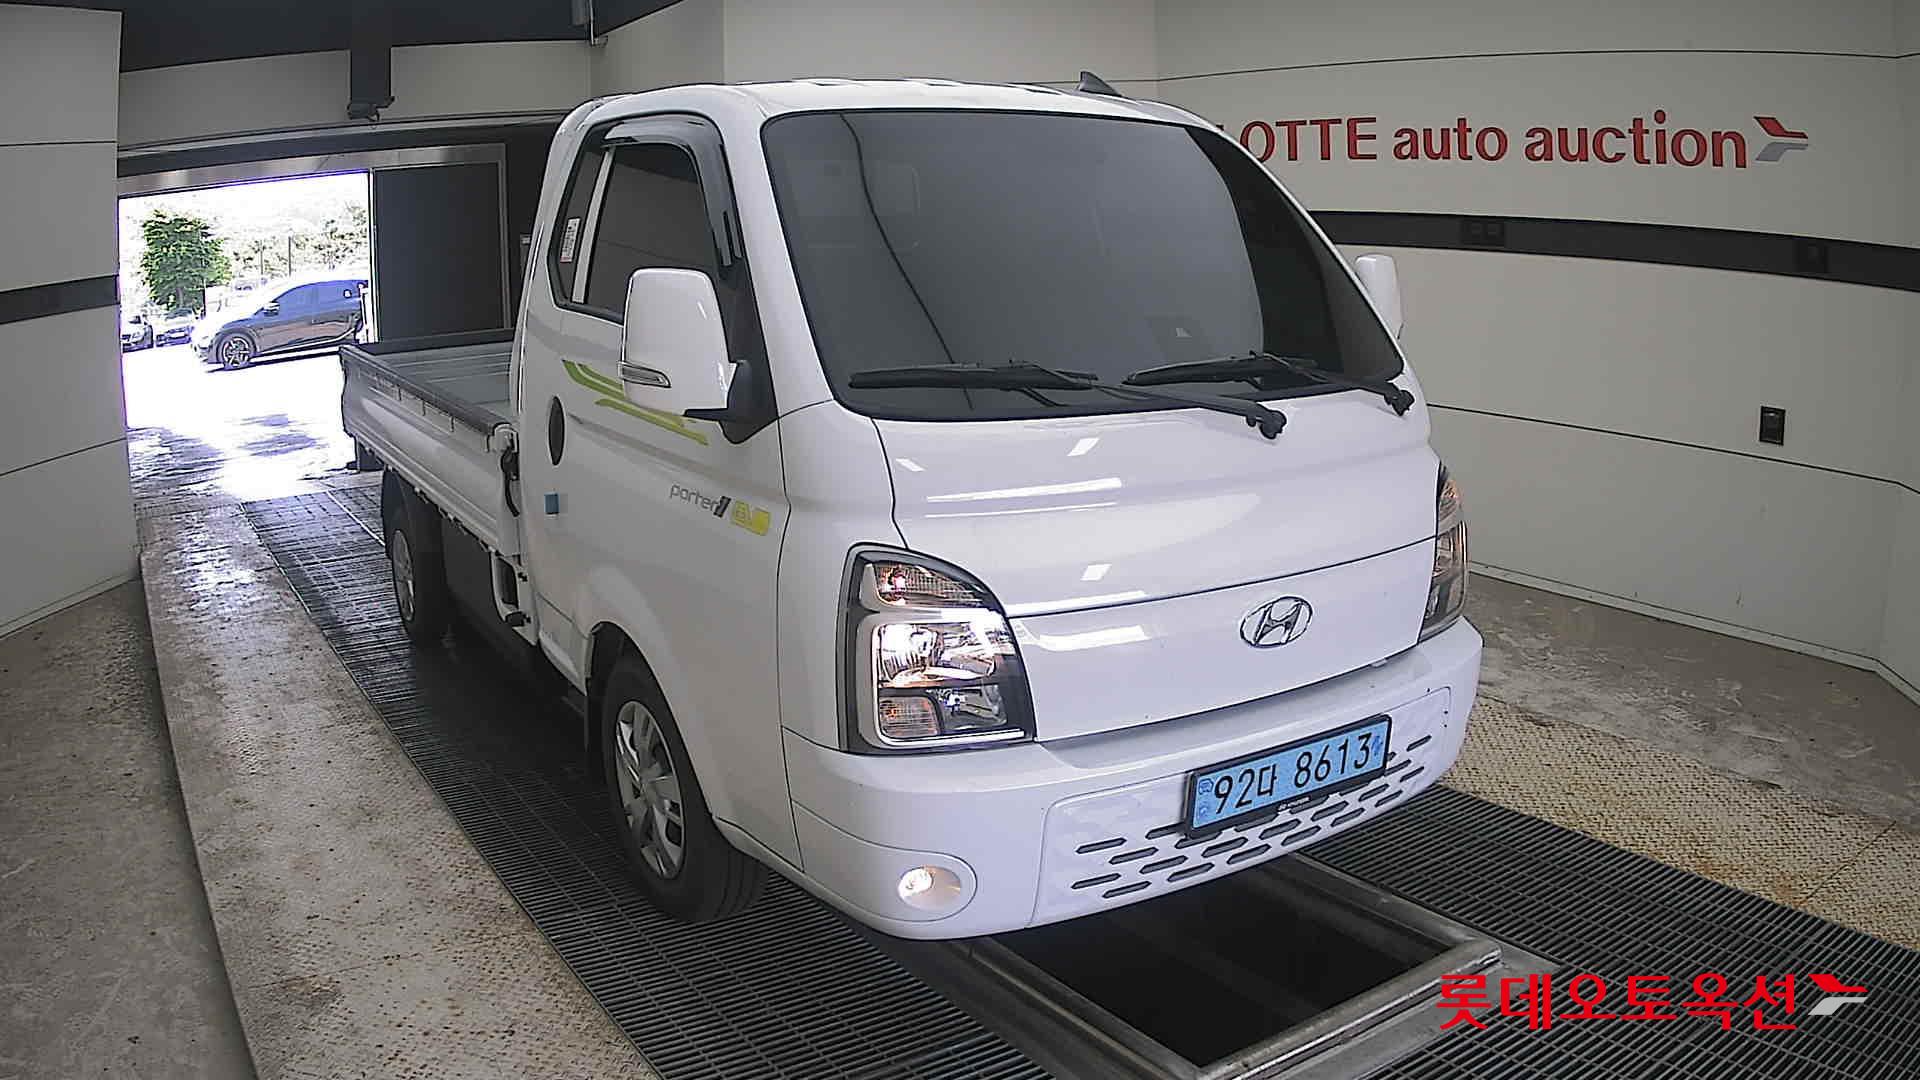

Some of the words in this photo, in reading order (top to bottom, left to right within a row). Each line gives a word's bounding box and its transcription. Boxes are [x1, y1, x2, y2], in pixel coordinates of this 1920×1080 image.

[1216, 117, 1377, 163] OTTE
[1393, 117, 1508, 162] auto
[1524, 110, 1747, 169] auction
[1213, 763, 1278, 815] 92다
[1294, 732, 1373, 788] 8613
